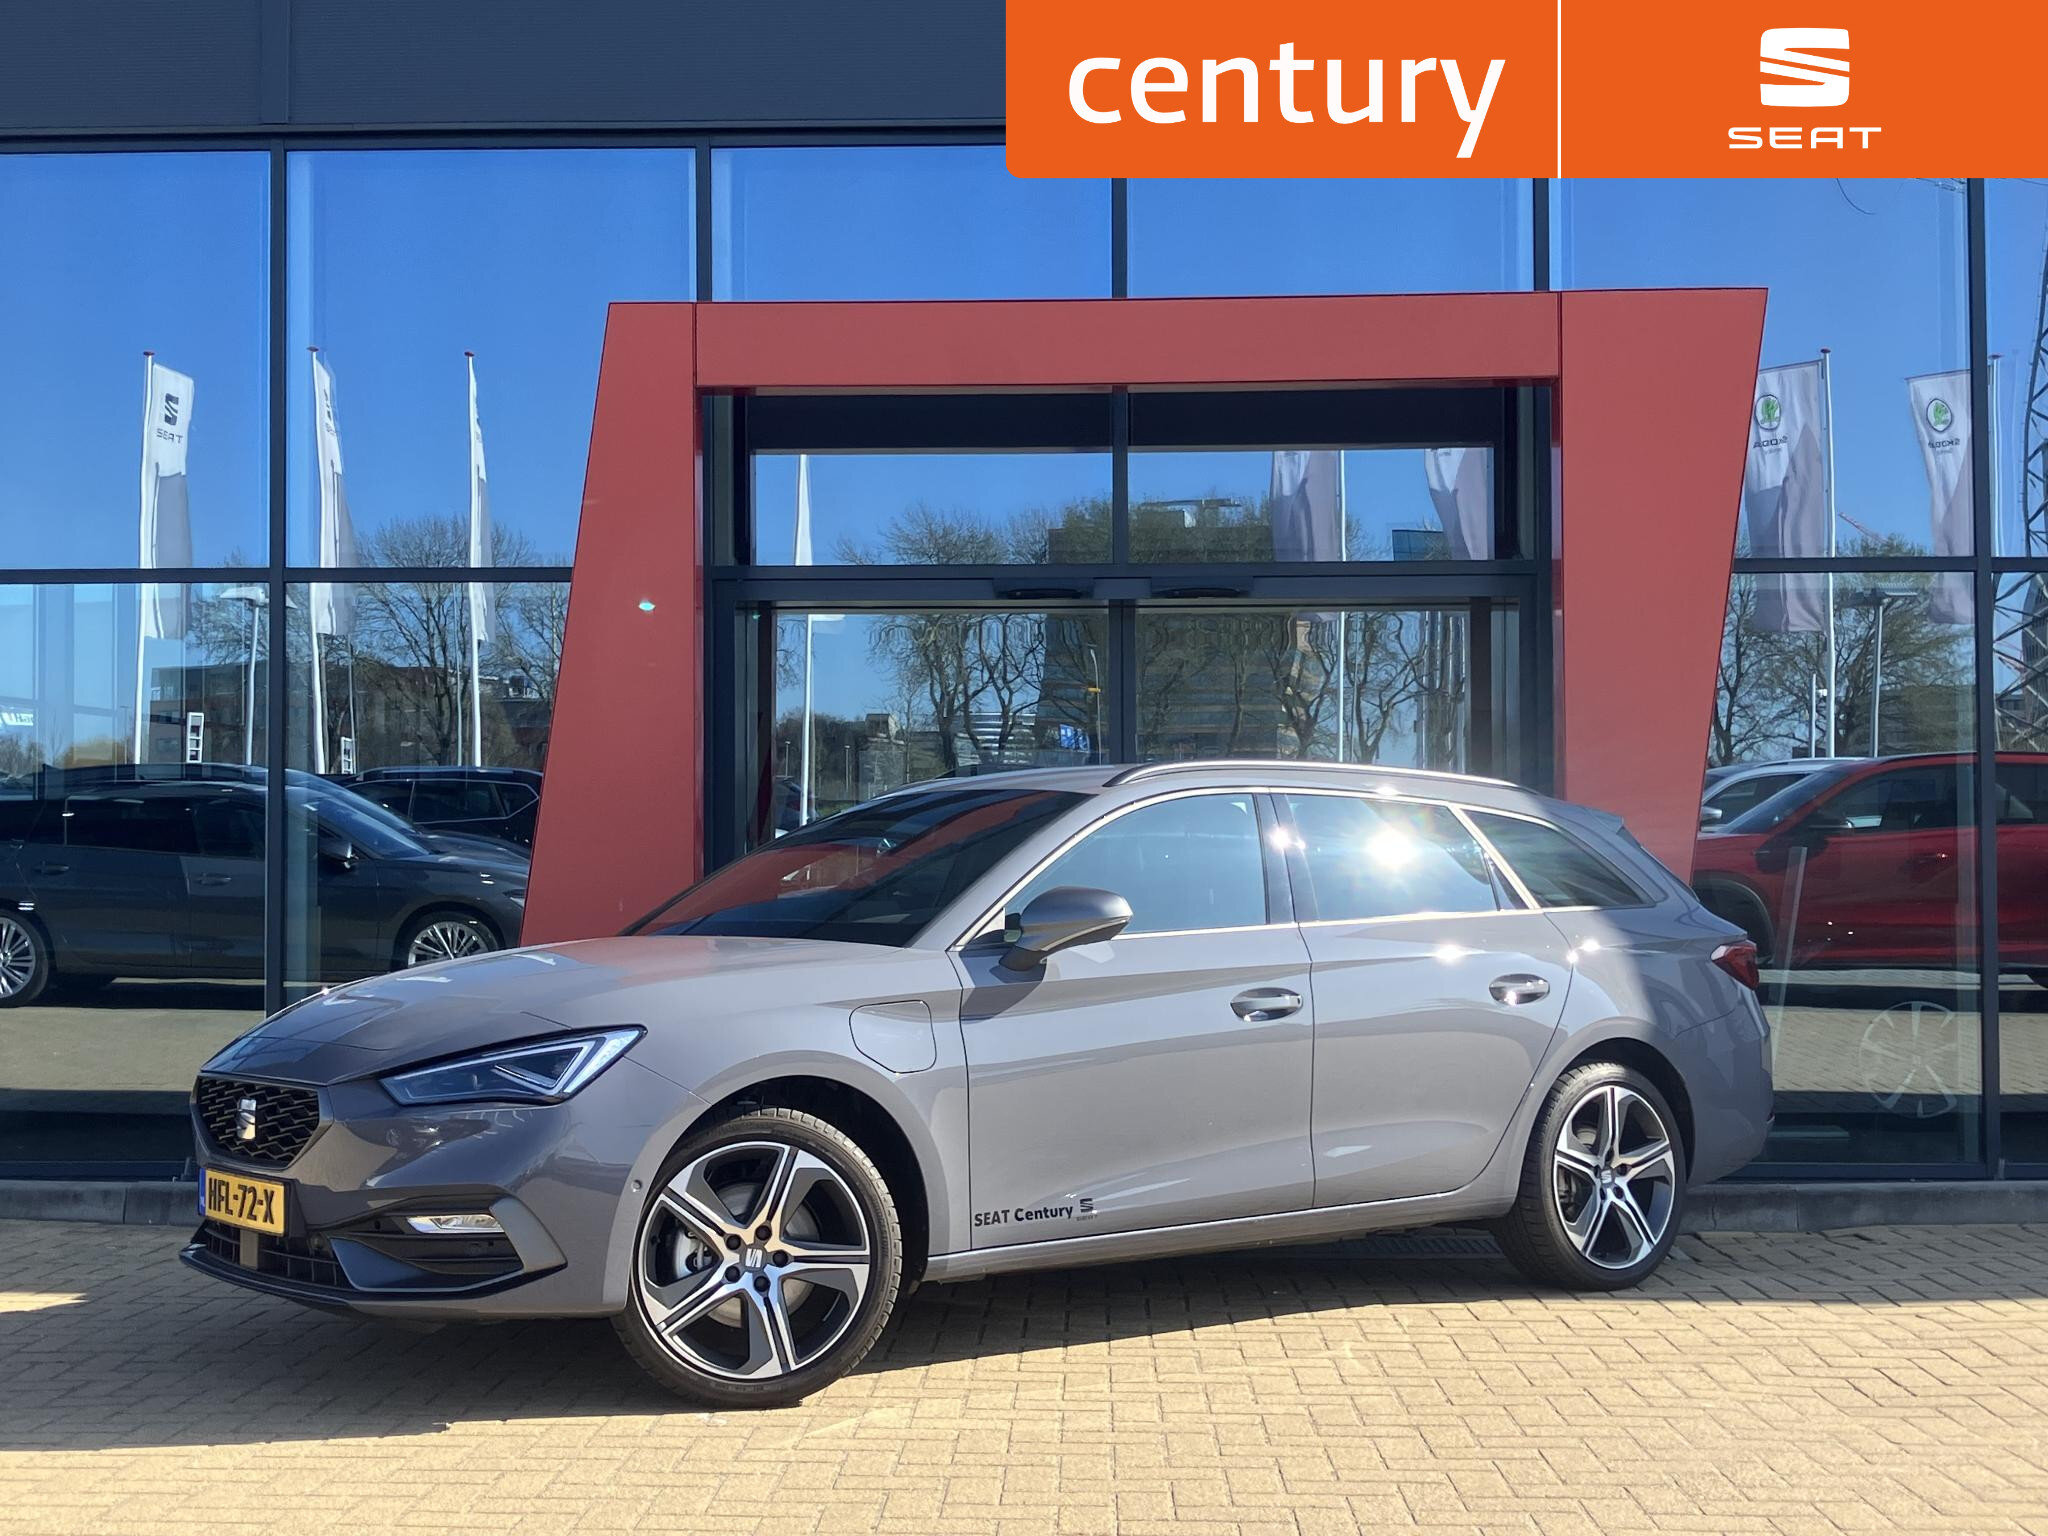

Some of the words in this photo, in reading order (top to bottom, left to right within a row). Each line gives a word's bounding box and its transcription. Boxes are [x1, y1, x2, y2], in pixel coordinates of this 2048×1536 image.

[156, 428, 183, 444] SEAT
[208, 1177, 275, 1225] HFL-72-X
[974, 1209, 1010, 1227] SEAT
[1014, 1206, 1073, 1222] Century
